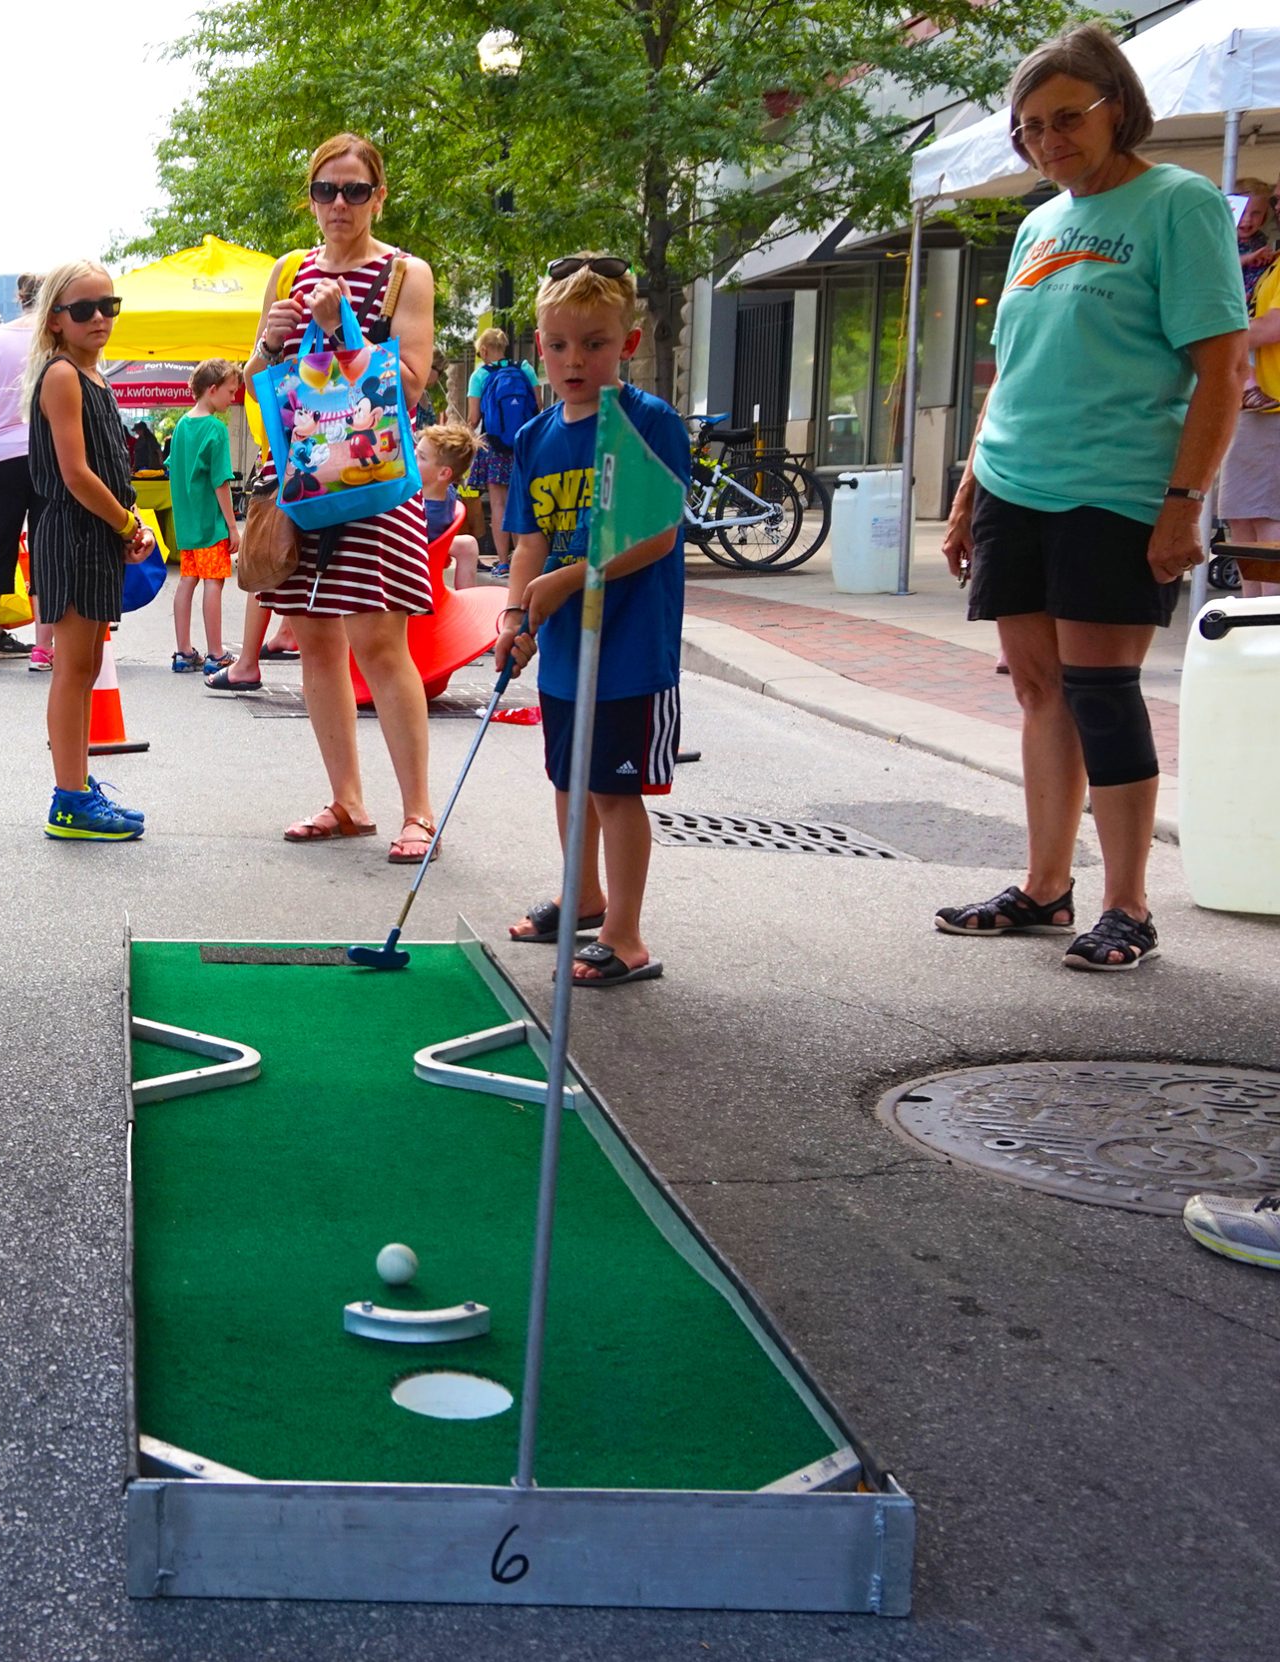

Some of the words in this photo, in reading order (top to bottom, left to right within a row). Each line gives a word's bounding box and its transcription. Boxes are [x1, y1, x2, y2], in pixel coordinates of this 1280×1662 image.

[1046, 284, 1070, 292] FORT
[1073, 284, 1114, 300] WAYNE
[164, 363, 194, 371] Wayne
[491, 1524, 530, 1584] 6
